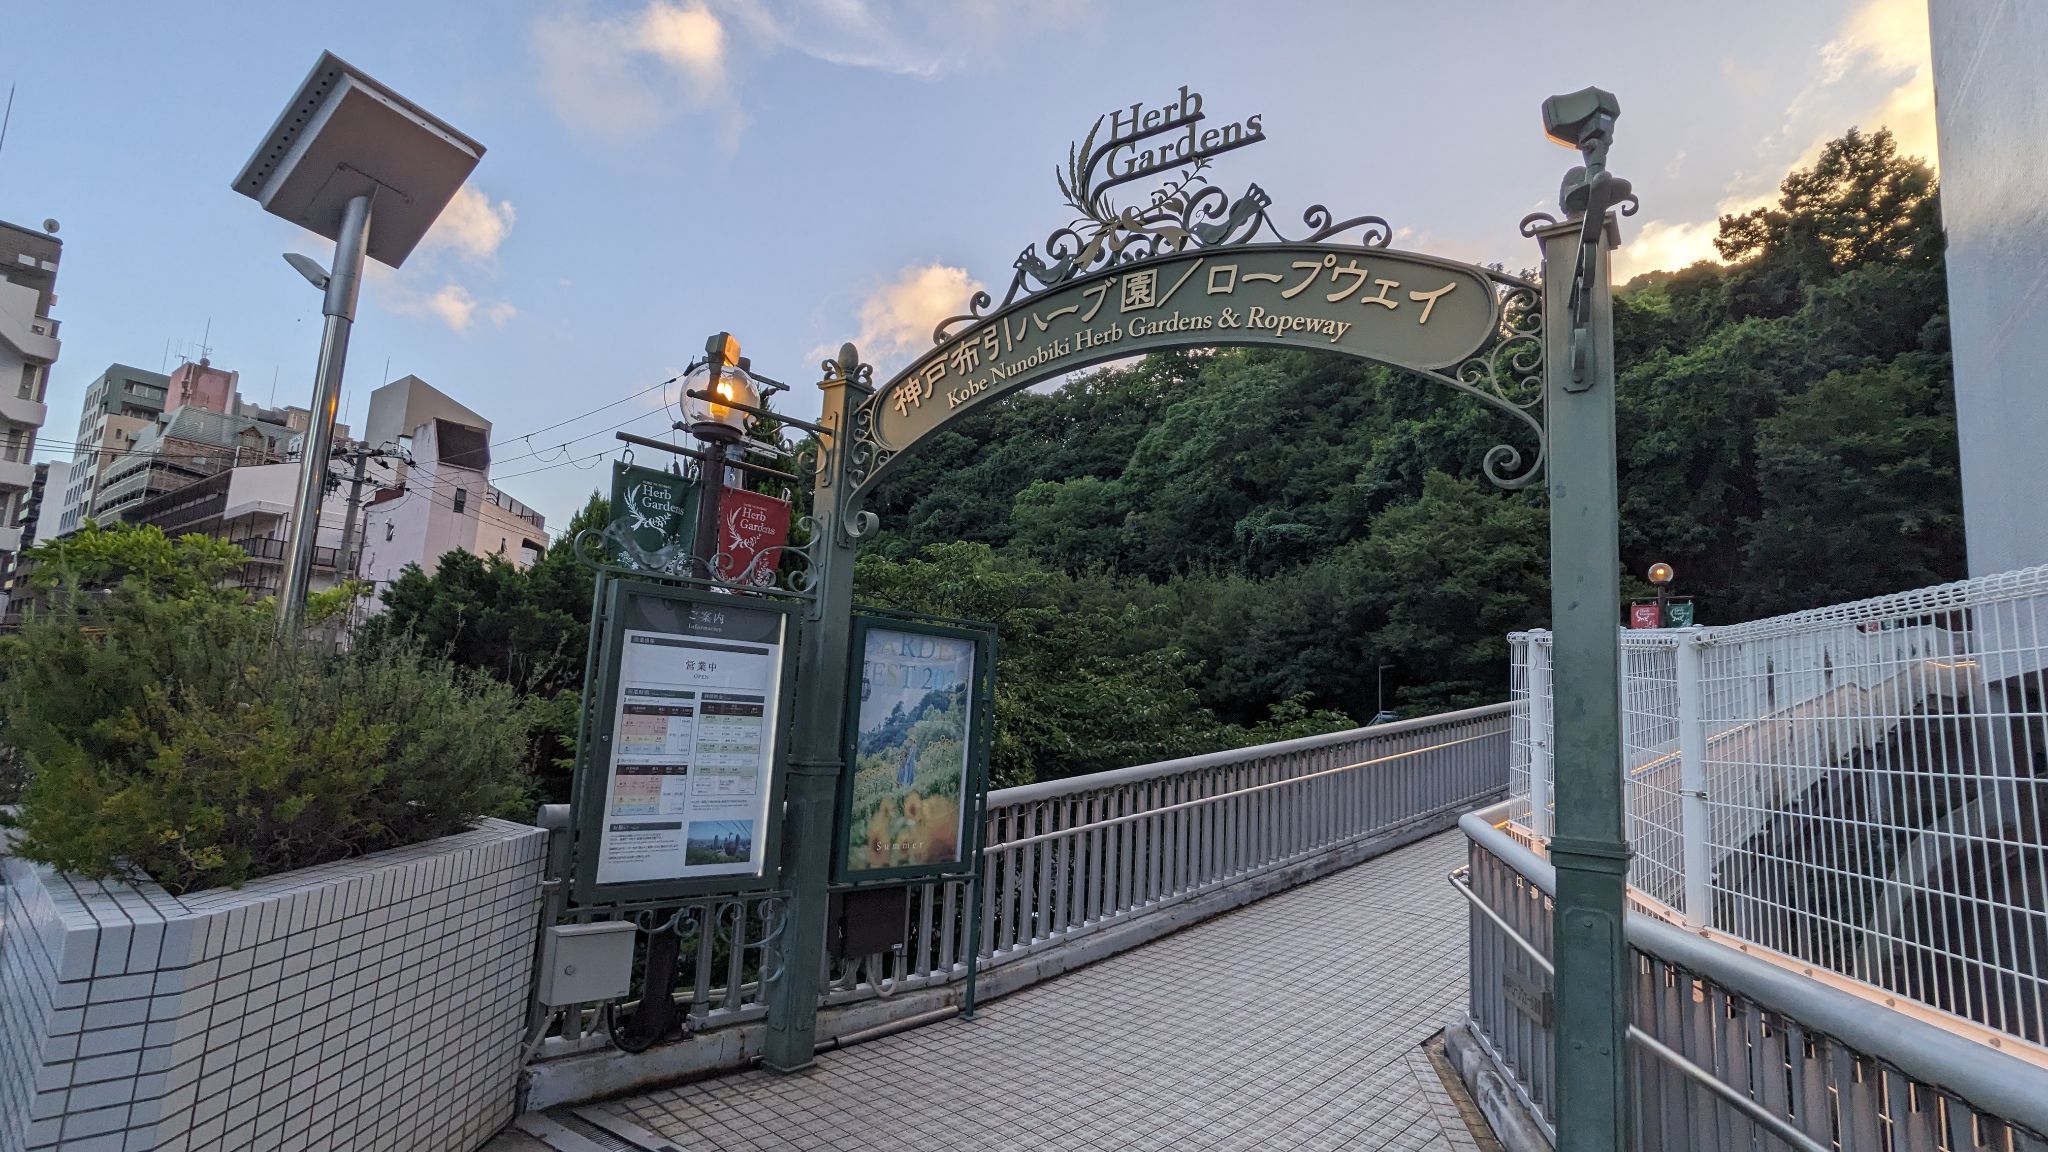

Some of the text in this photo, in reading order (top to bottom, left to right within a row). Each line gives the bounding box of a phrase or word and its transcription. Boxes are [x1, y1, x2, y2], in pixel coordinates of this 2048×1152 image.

[1110, 85, 1203, 143] Herb
[1106, 114, 1263, 180] Gardens
[947, 306, 1352, 410] Kobe Nunobiki Herb Gardens & Ropeway
[642, 484, 672, 499] Herb
[642, 497, 685, 516] Gardens
[741, 507, 767, 522] Herb
[740, 519, 776, 536] Gardens
[688, 610, 725, 624] ご案内
[685, 659, 717, 673] 営業中
[876, 841, 925, 851] Summer
